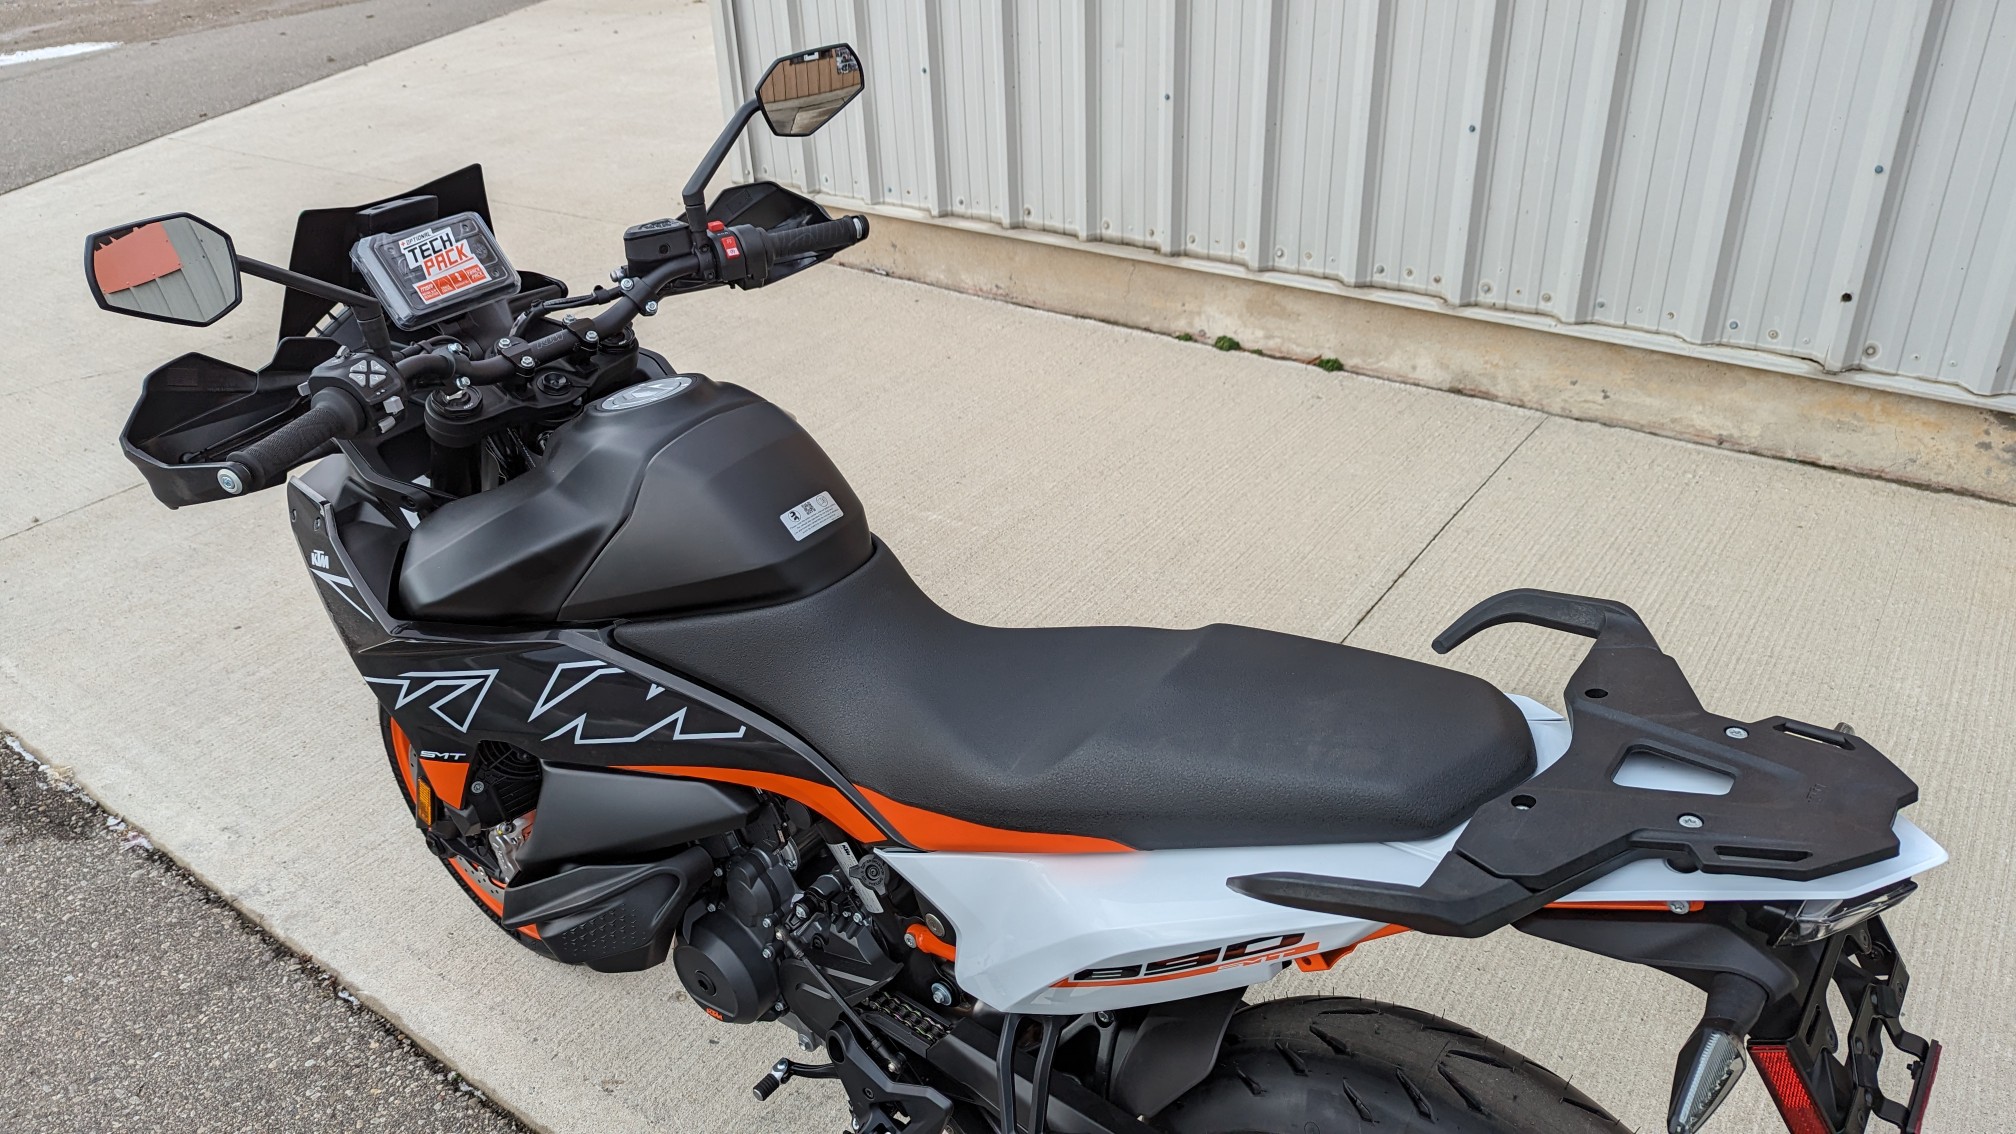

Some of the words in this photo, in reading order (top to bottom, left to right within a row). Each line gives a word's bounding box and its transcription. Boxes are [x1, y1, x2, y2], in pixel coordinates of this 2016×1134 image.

[406, 231, 433, 246] OPTIONAL
[408, 232, 454, 264] TECH
[423, 242, 469, 277] PACK
[310, 549, 330, 570] KTM
[419, 750, 467, 761] SMT
[1073, 932, 1306, 981] 890
